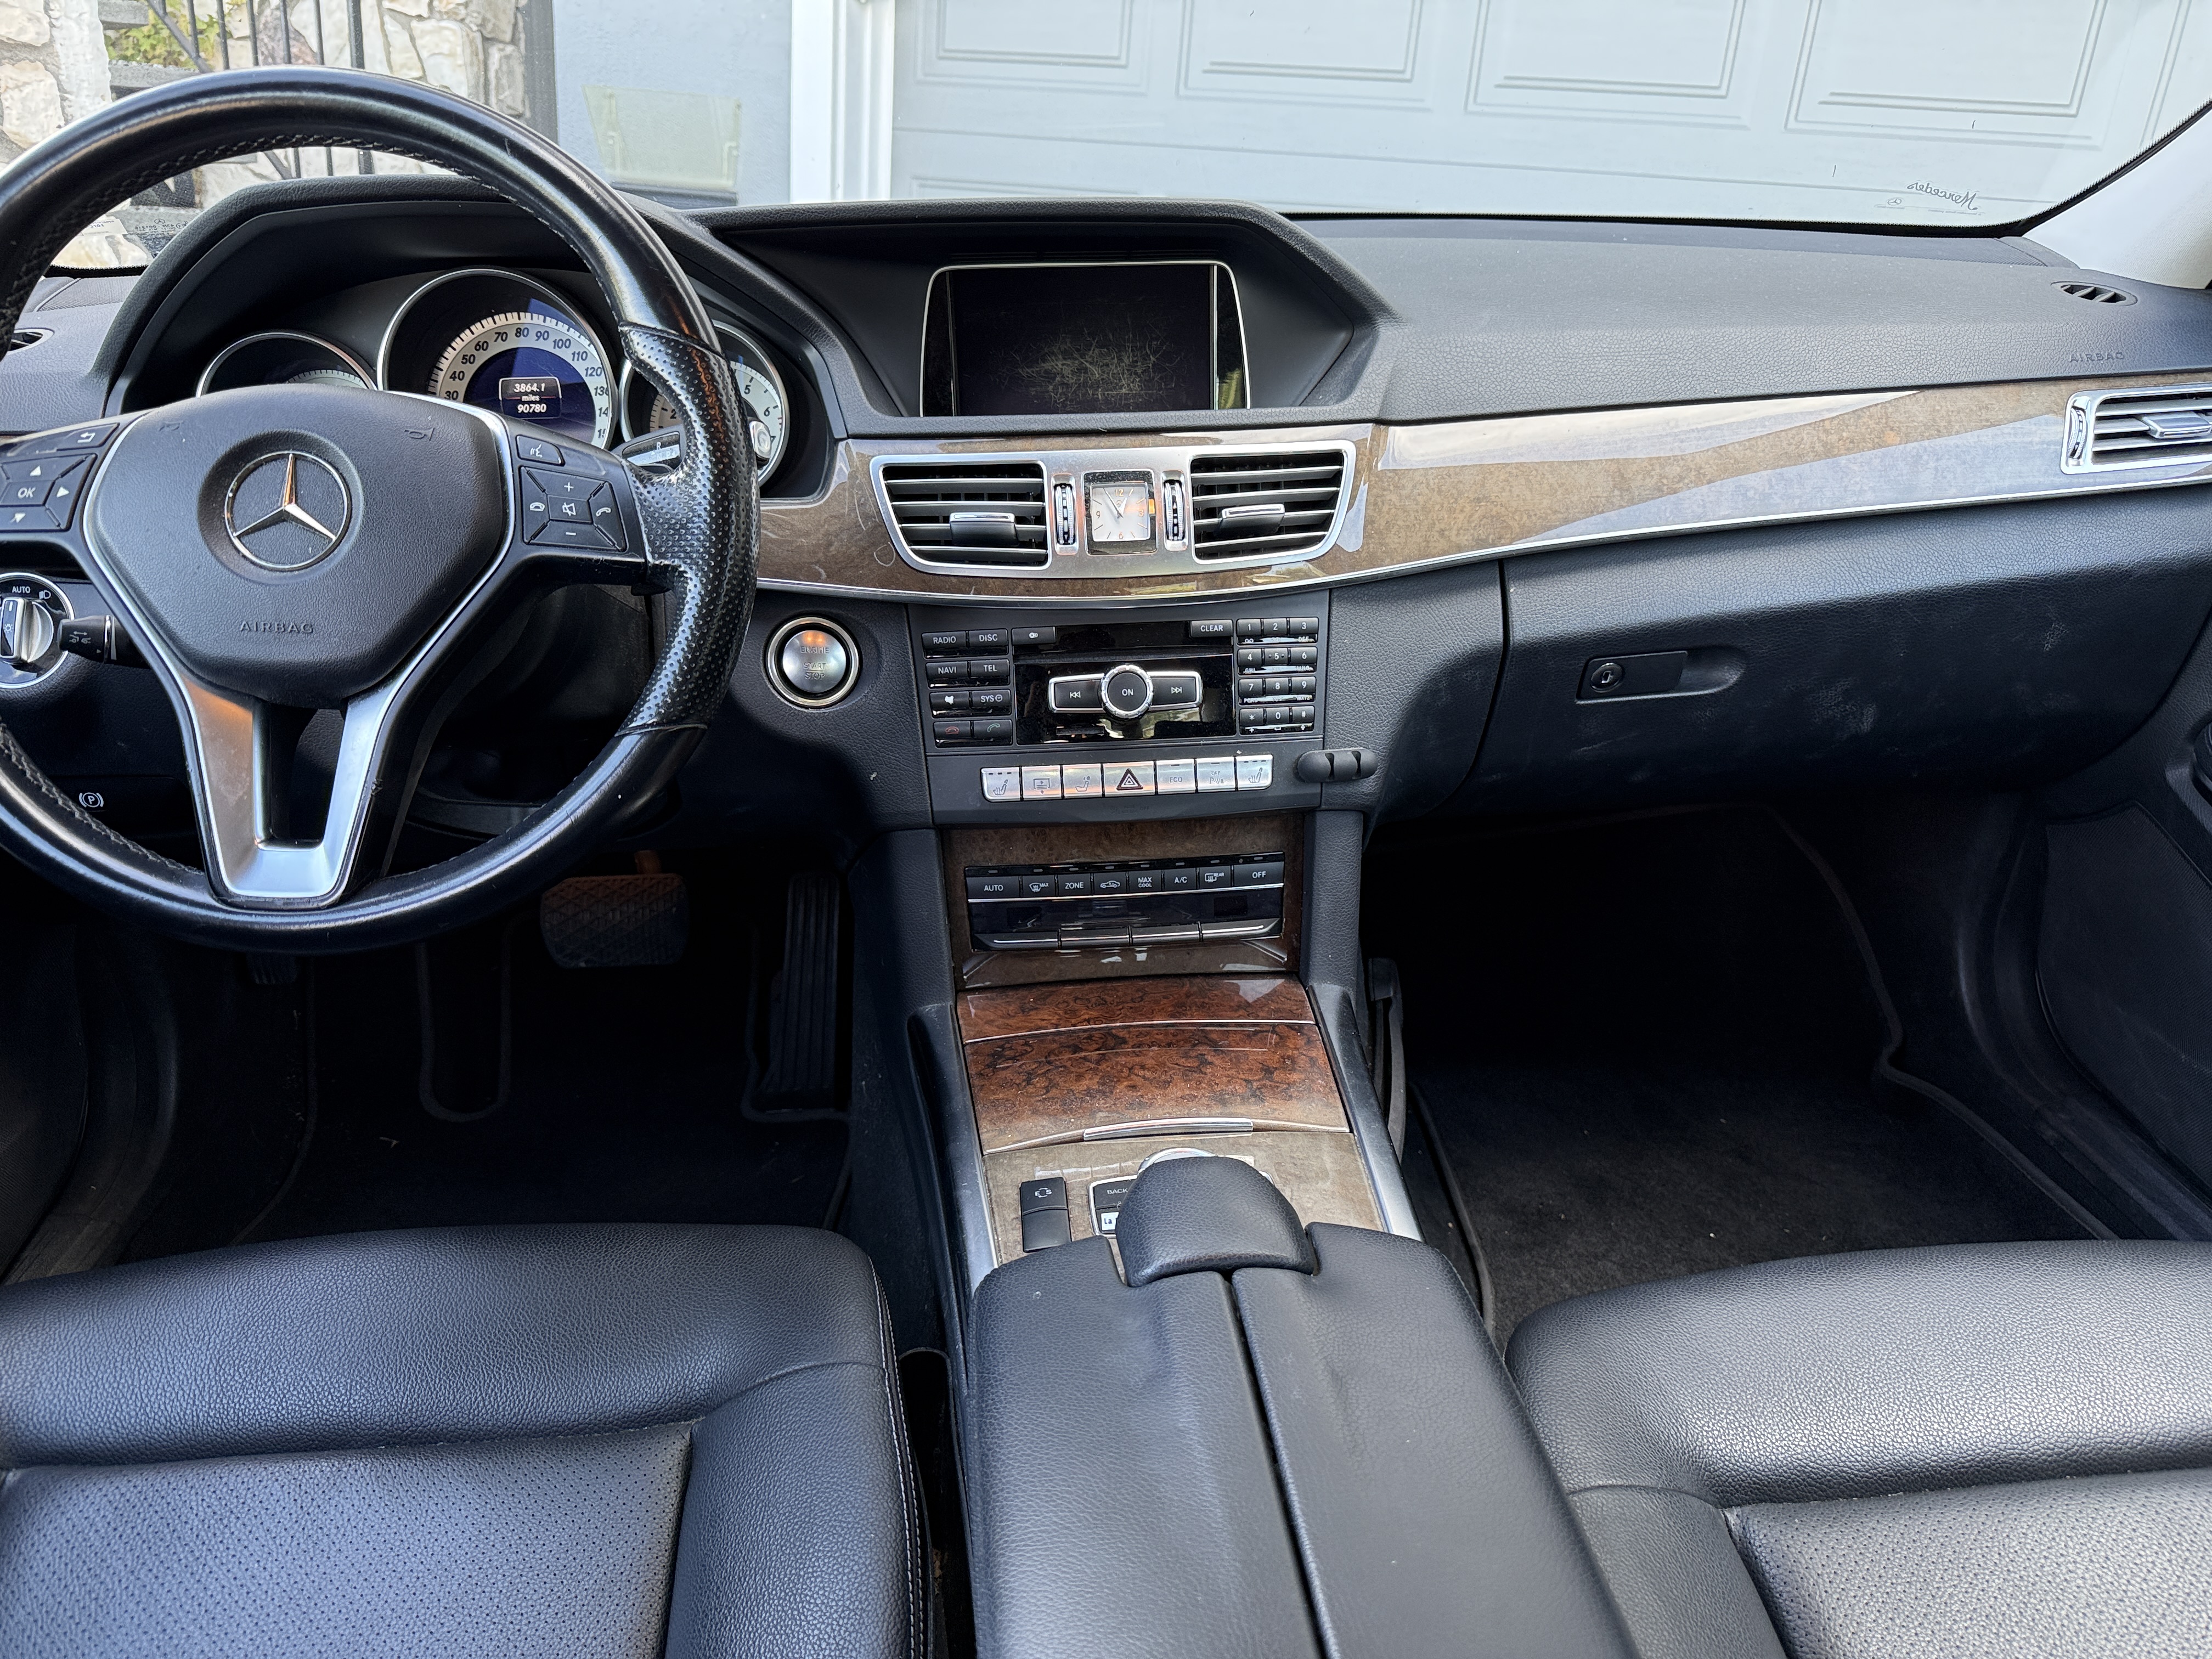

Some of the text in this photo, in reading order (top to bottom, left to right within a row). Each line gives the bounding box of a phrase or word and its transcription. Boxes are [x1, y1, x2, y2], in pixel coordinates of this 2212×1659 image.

[494, 331, 508, 342] 70
[515, 327, 529, 338] 80
[535, 330, 549, 341] 90
[475, 341, 489, 352] 60
[552, 338, 572, 349] 100
[461, 354, 476, 365] 50
[571, 351, 588, 362] 110
[2069, 352, 2125, 363] AIRBAG
[449, 370, 465, 381] 40
[585, 366, 602, 377] 120
[514, 382, 545, 393] 3864.1
[744, 385, 751, 394] 5
[444, 390, 459, 400] 30
[517, 404, 547, 413] 90780
[764, 407, 771, 417] 6
[670, 409, 677, 419] 2
[18, 487, 36, 498] OK
[1115, 488, 1124, 496] 12
[1139, 509, 1144, 517] 3
[240, 620, 313, 634] AIRBAG
[1302, 622, 1307, 630] 3
[933, 636, 956, 644] RADIO
[979, 634, 998, 642] DISC
[800, 646, 830, 654] ENGINE
[1247, 653, 1253, 661] 4
[983, 664, 997, 672] TEL
[1249, 683, 1254, 691] 7
[1302, 681, 1307, 689] 9
